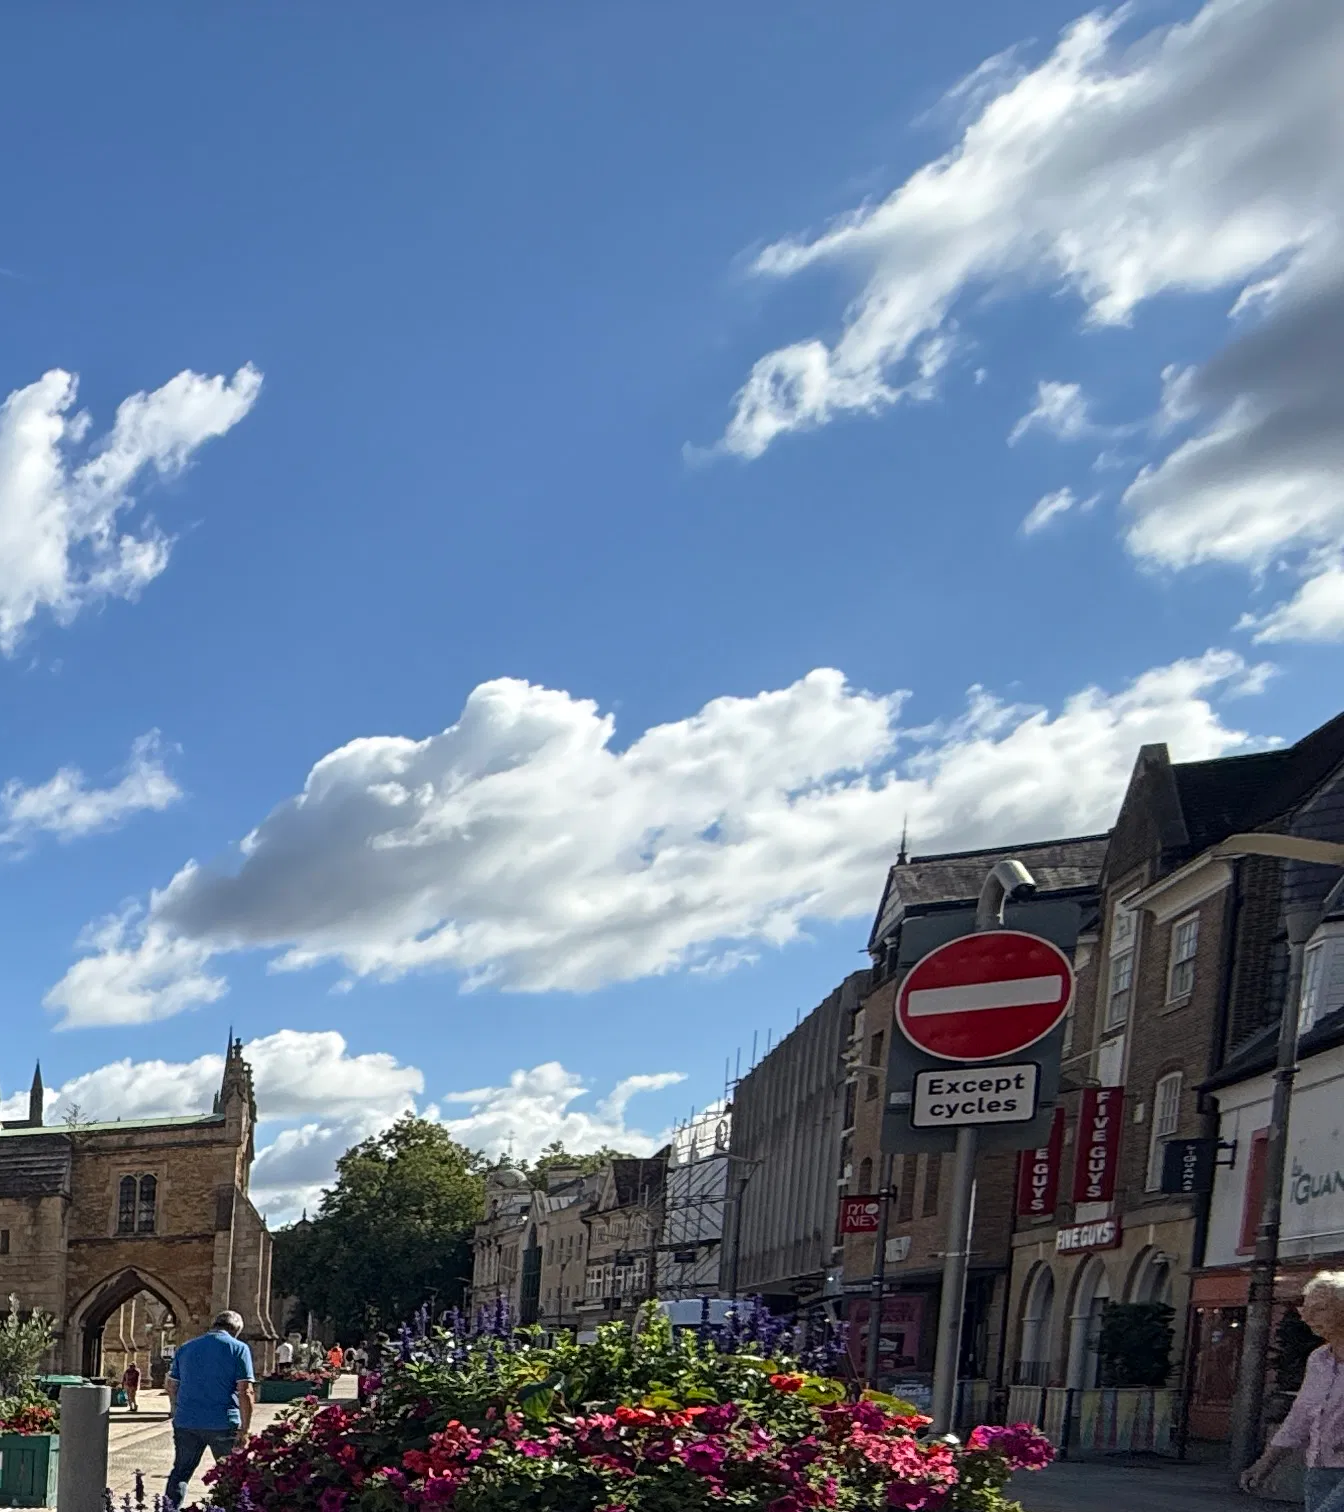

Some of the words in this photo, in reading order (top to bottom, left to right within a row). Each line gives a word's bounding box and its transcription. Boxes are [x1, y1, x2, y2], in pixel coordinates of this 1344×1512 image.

[928, 1073, 1025, 1095] Except
[929, 1097, 1017, 1118] cycles
[1092, 1091, 1111, 1142] FIVE
[1031, 1163, 1049, 1210] GUYS
[1086, 1147, 1107, 1197] GUYS
[1056, 1227, 1079, 1250] FIVE
[1080, 1221, 1114, 1247] GUYS
